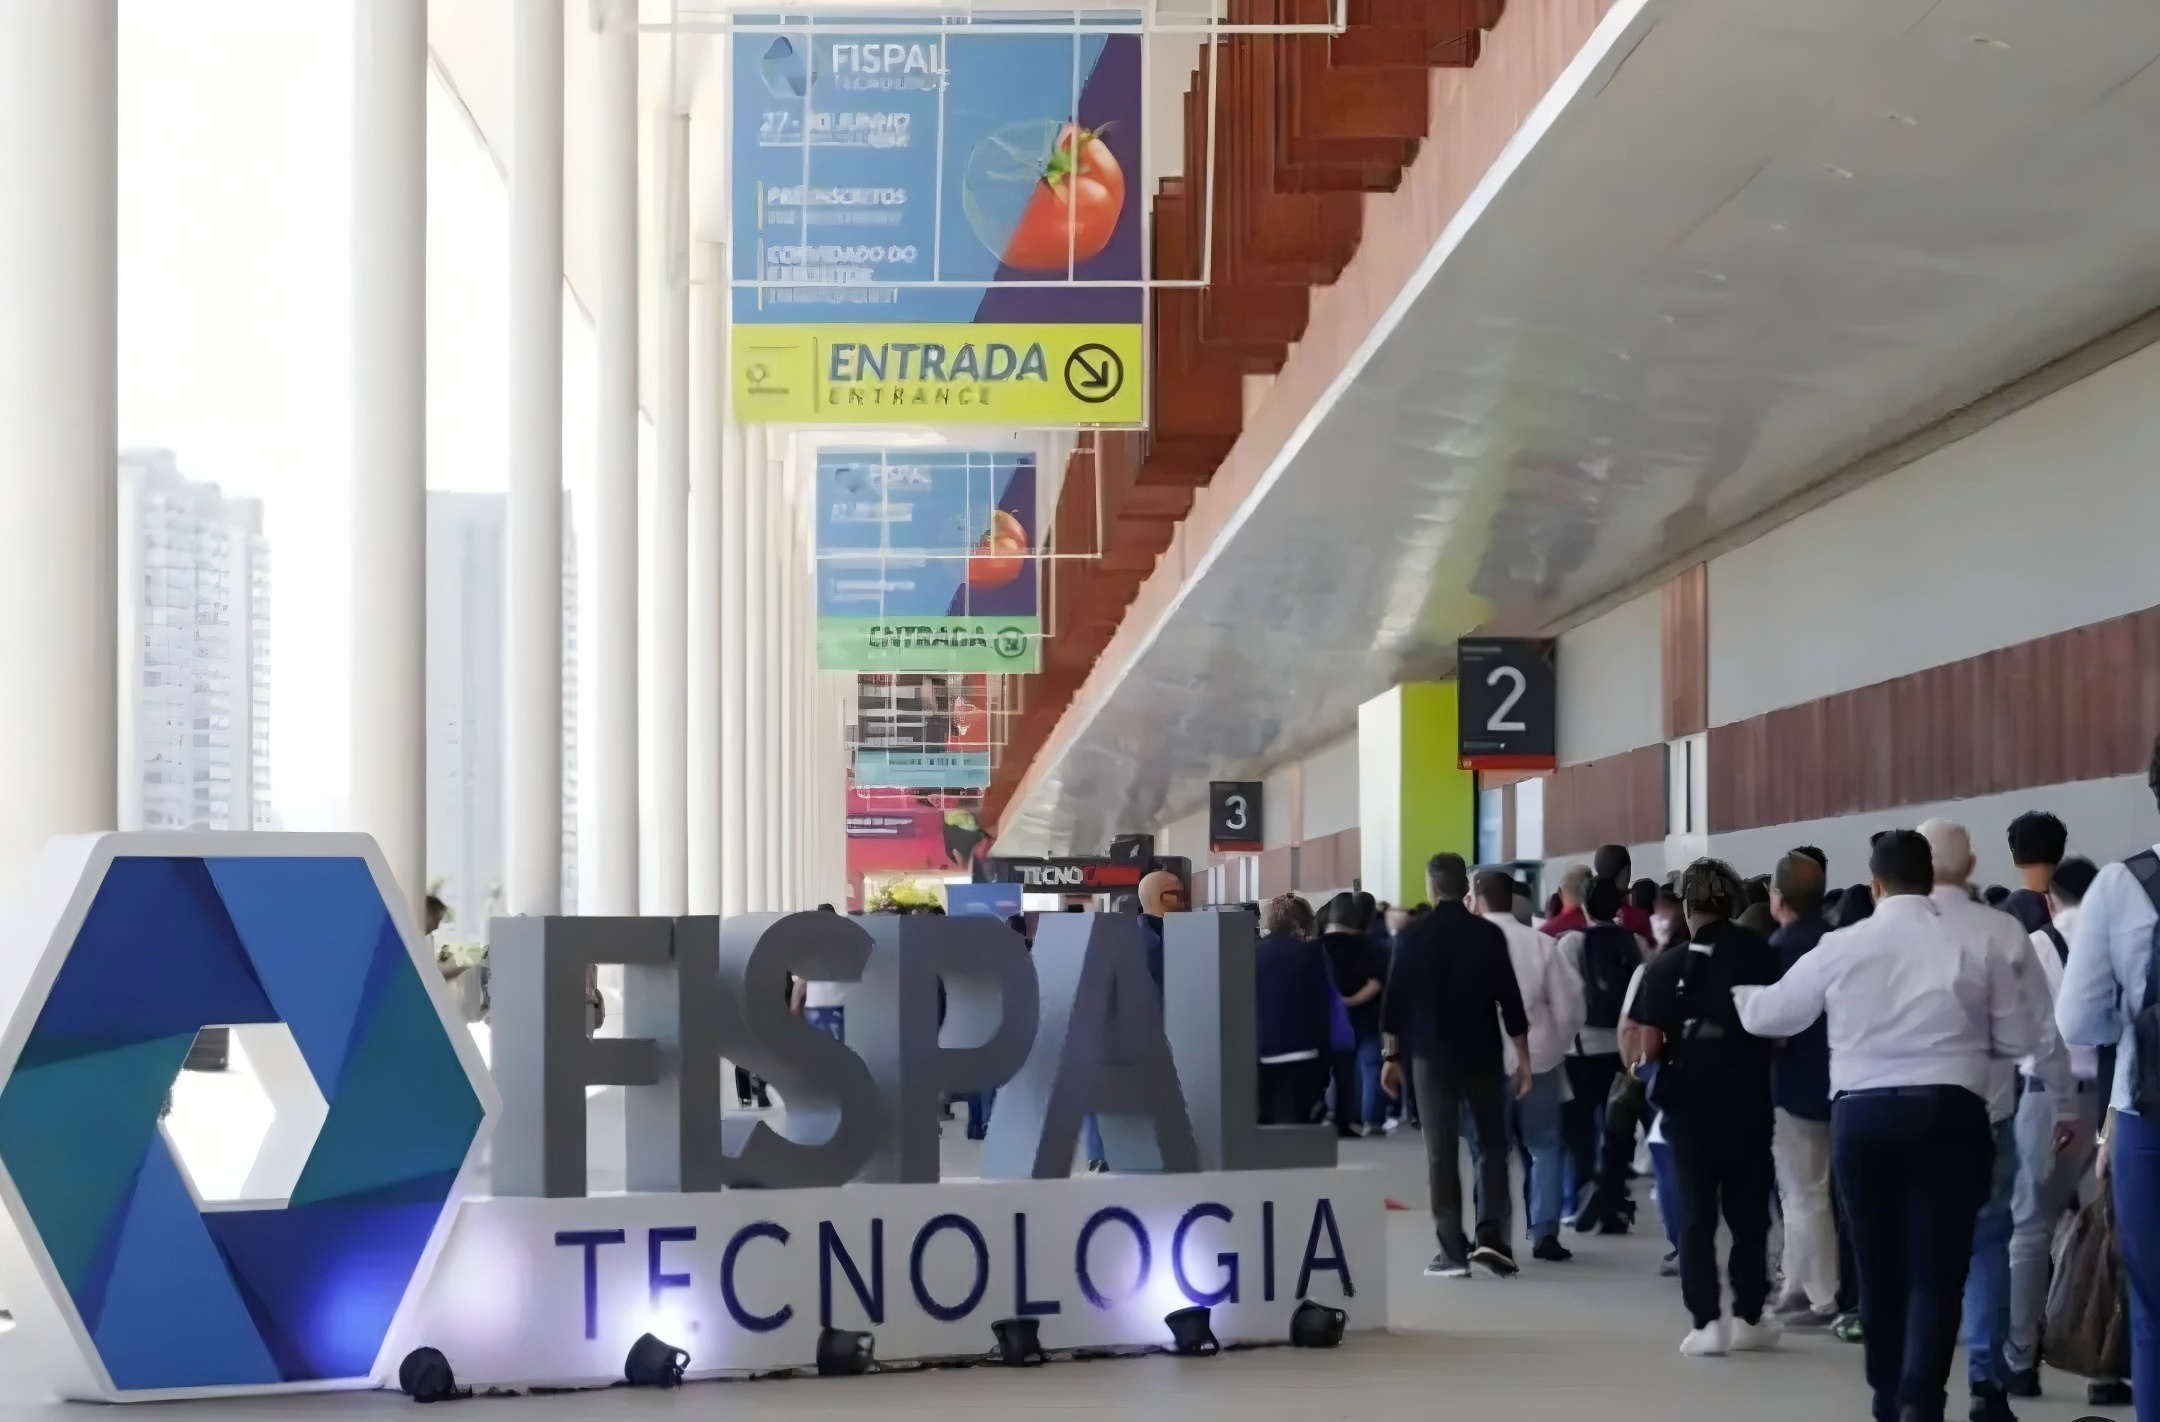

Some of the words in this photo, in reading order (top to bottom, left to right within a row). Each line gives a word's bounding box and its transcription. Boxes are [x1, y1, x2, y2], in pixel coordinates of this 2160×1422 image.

[832, 43, 949, 74] FISPAL
[830, 342, 1048, 382] ENTRADA
[1486, 665, 1527, 732] 2
[1225, 795, 1247, 830] 3
[545, 911, 1338, 1197] FISPAL
[554, 1198, 1356, 1341] TECNOLOGIA
